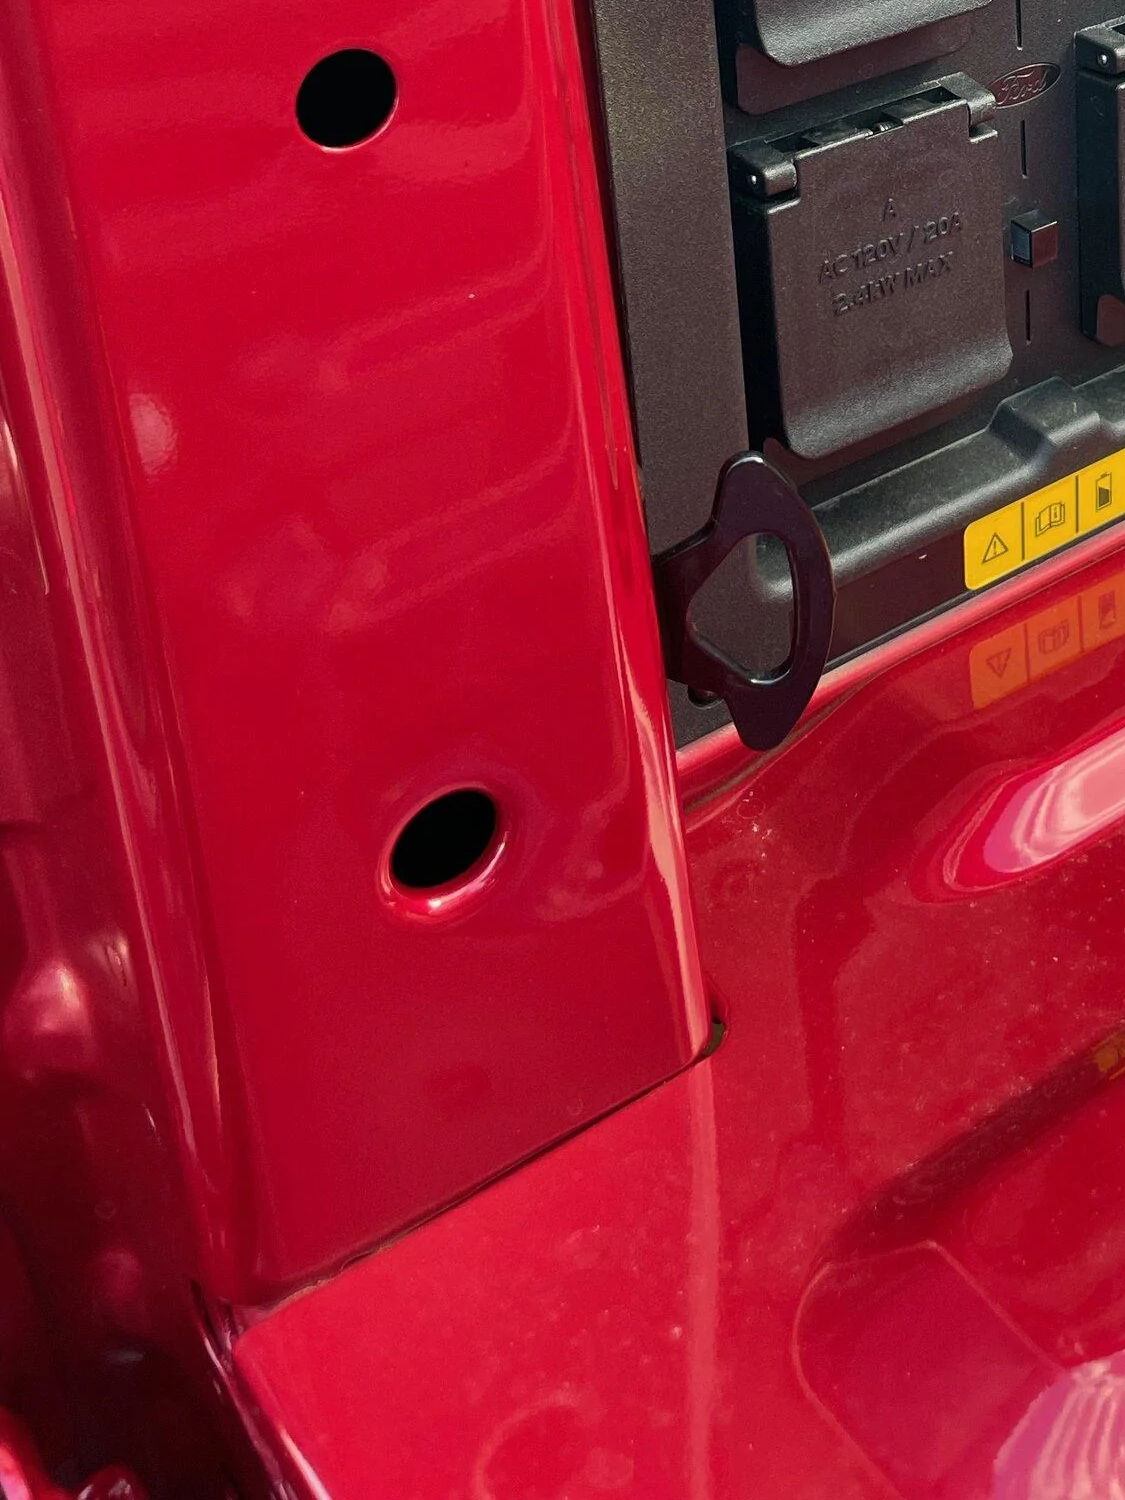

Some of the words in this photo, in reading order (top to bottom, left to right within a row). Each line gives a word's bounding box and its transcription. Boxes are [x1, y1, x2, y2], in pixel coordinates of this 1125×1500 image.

[995, 69, 1048, 106] Ford
[881, 198, 896, 222] A
[923, 211, 962, 244] 20A
[904, 251, 954, 290] MAX
